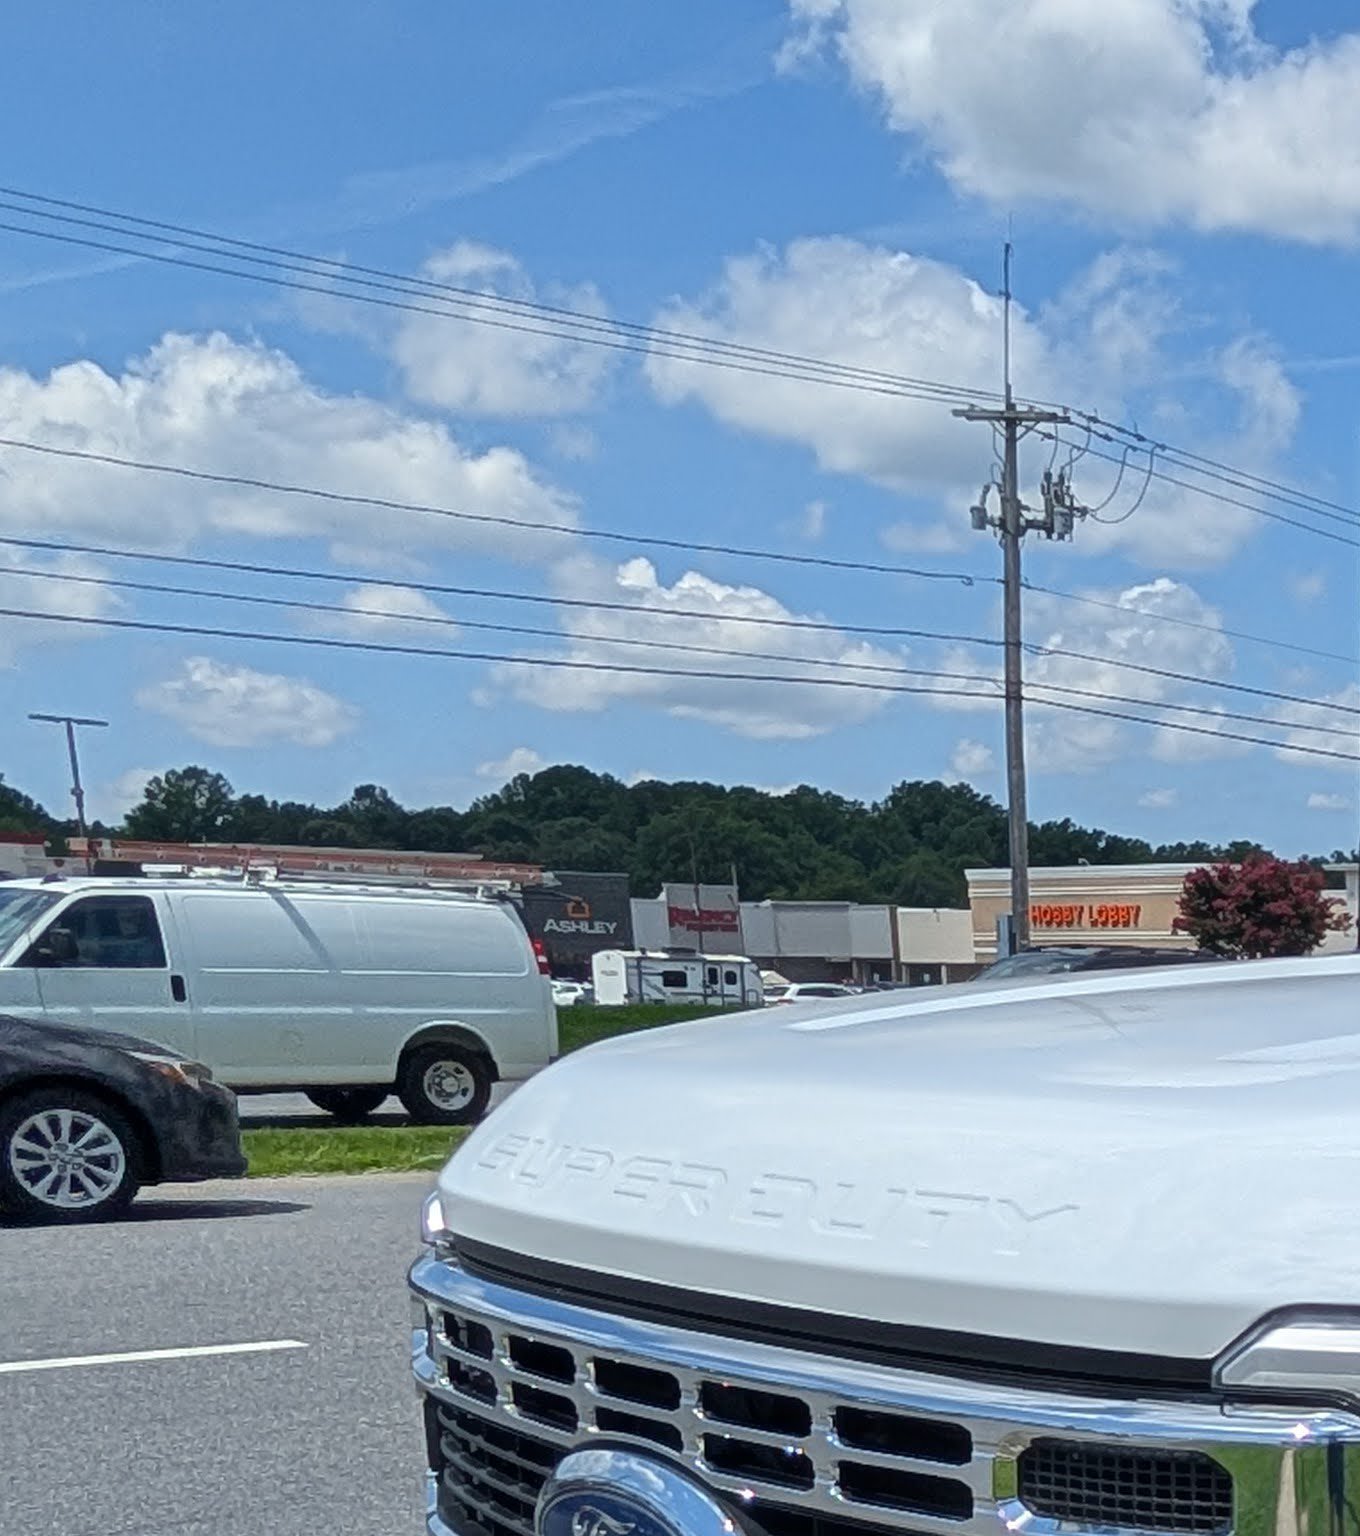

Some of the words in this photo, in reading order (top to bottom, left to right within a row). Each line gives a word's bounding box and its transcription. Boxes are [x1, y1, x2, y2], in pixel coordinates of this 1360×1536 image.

[544, 919, 618, 934] ASHLEY
[1031, 904, 1084, 928] HOBBY
[1088, 904, 1141, 928] LOBBY
[478, 1134, 728, 1218] SUPER
[730, 1173, 1080, 1255] DUTY
